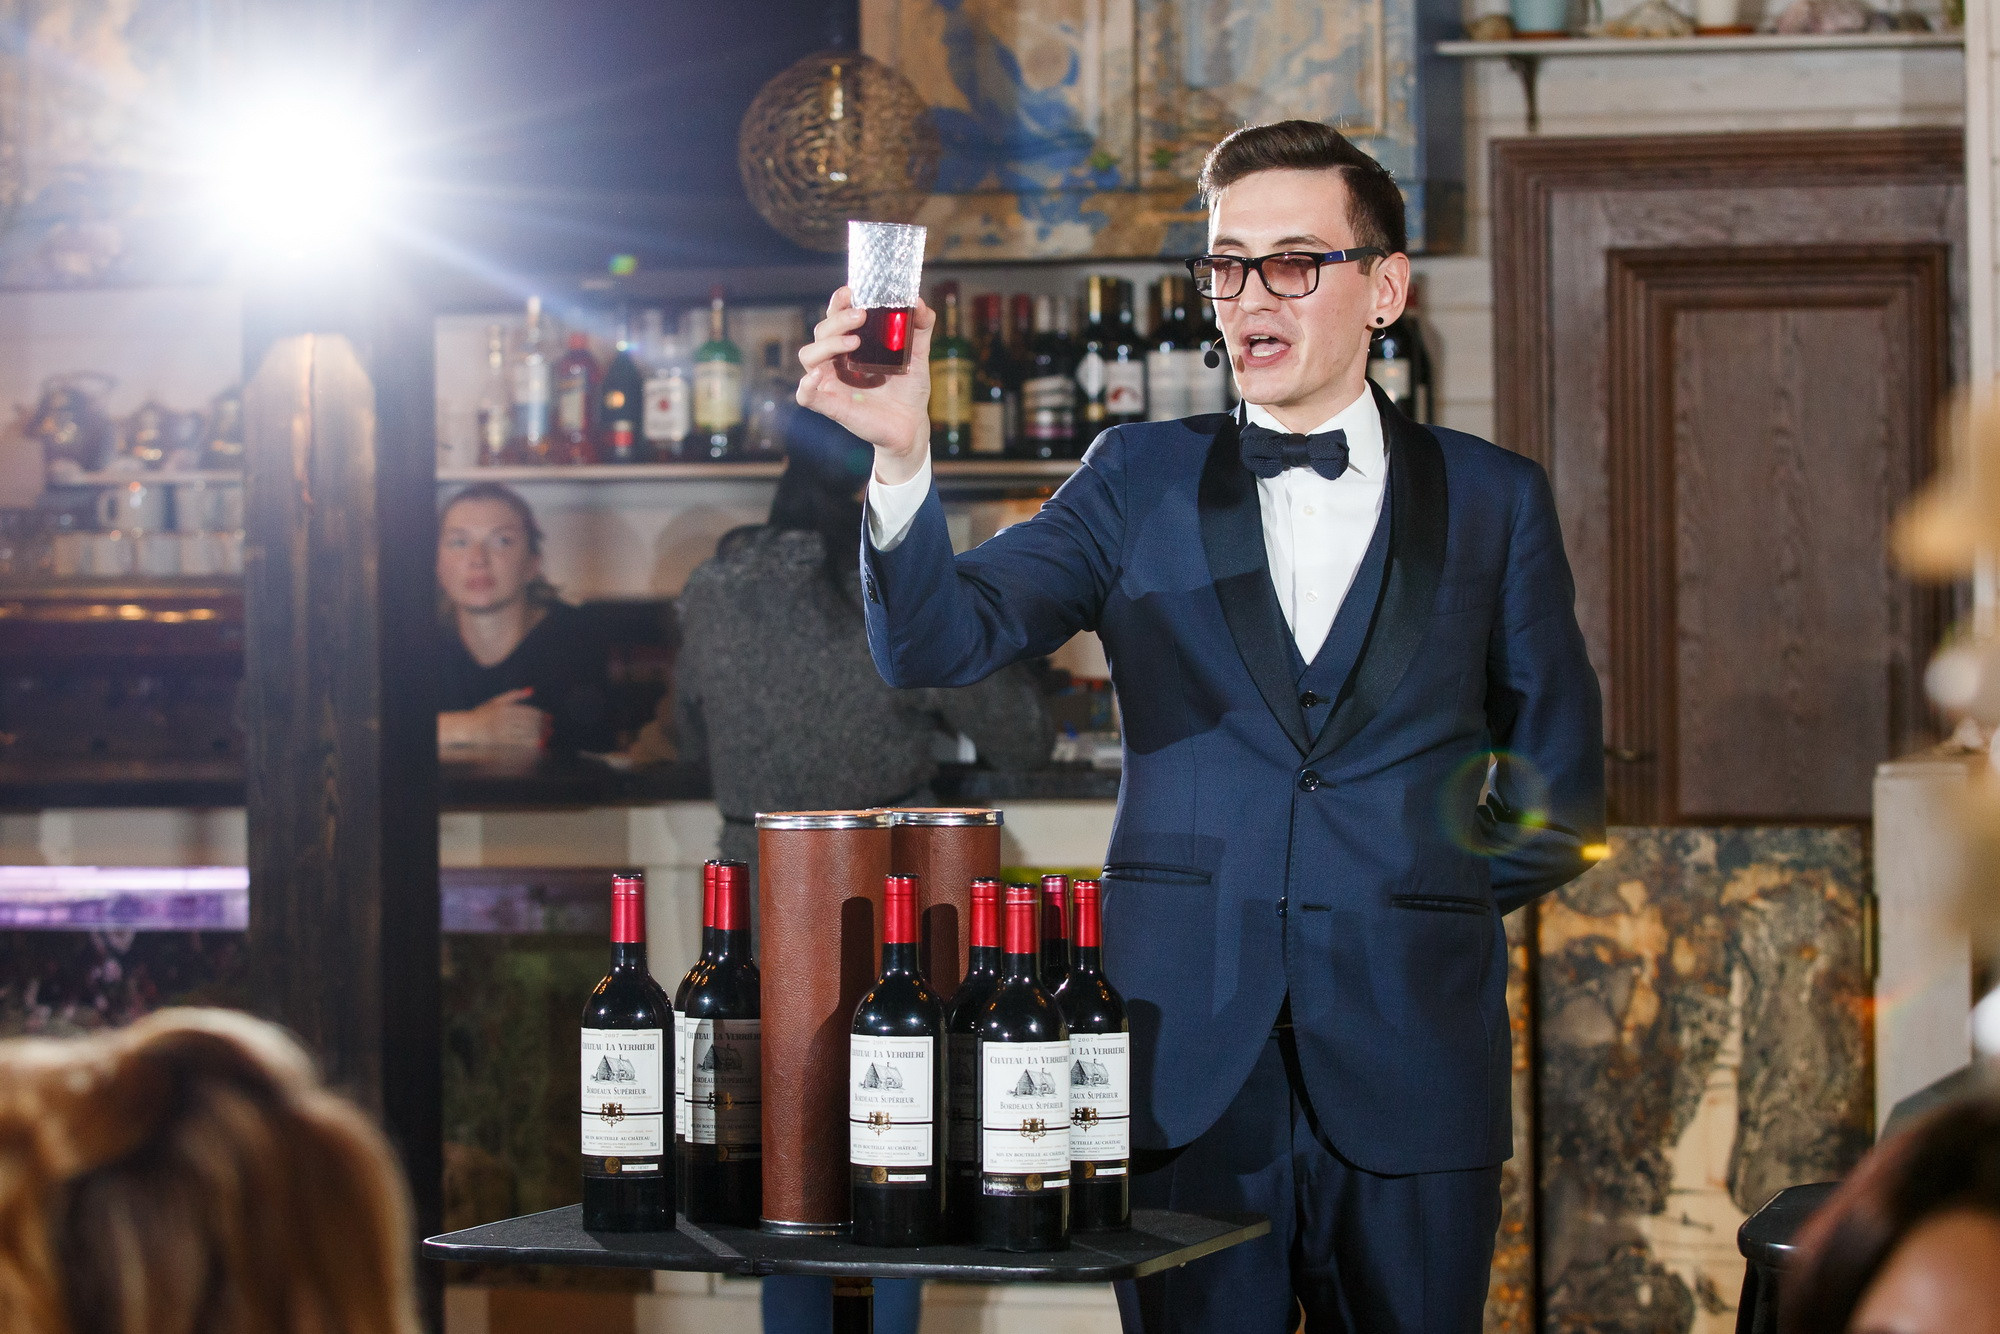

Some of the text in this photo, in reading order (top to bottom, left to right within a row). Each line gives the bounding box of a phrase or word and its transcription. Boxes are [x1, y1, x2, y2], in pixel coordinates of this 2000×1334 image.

[606, 1043, 616, 1051] LA
[1079, 1047, 1090, 1055] LA
[874, 1050, 884, 1058] LA
[1028, 1056, 1038, 1064] LA
[693, 1076, 718, 1084] ORDEAUX
